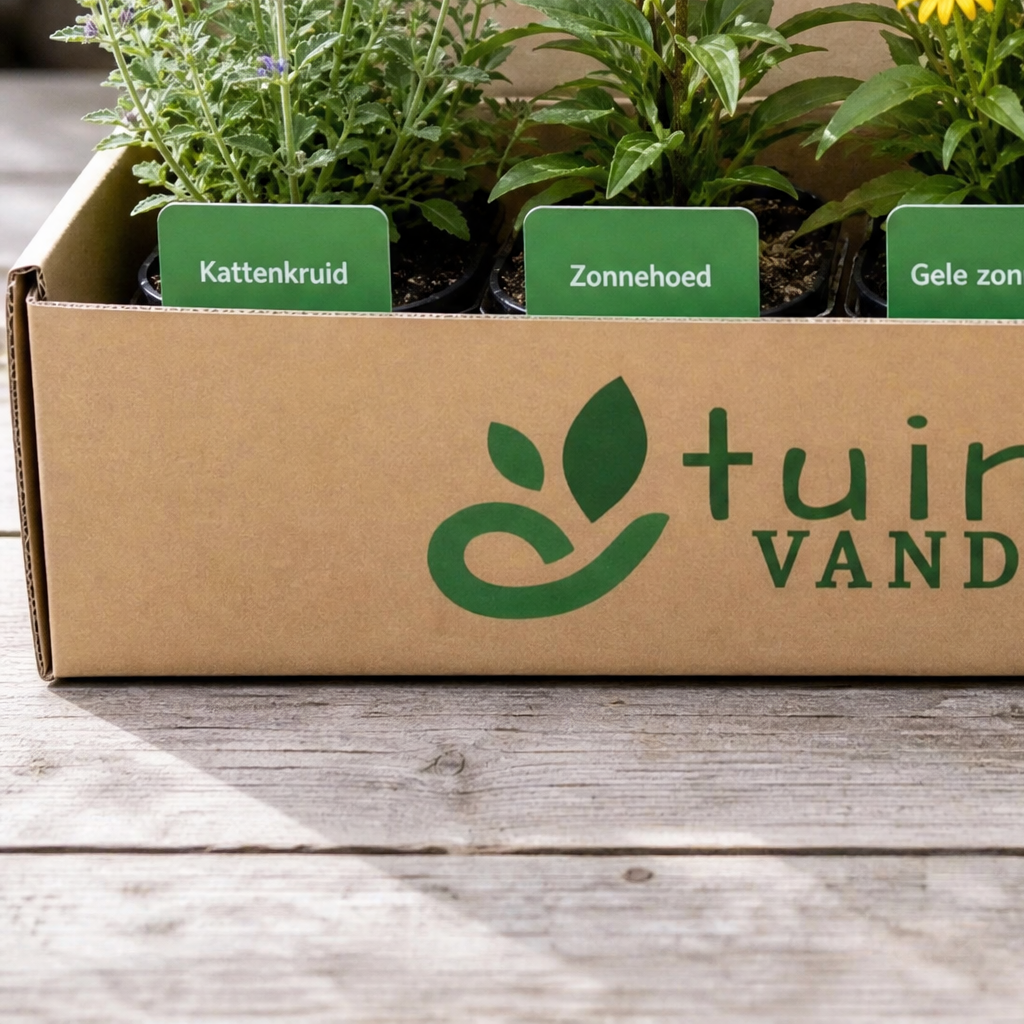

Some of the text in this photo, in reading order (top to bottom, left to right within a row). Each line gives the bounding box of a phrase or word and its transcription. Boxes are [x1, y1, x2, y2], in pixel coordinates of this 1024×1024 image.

[199, 260, 348, 285] Kattenkruid
[569, 263, 712, 288] Zonnehoed
[911, 262, 968, 286] Gele
